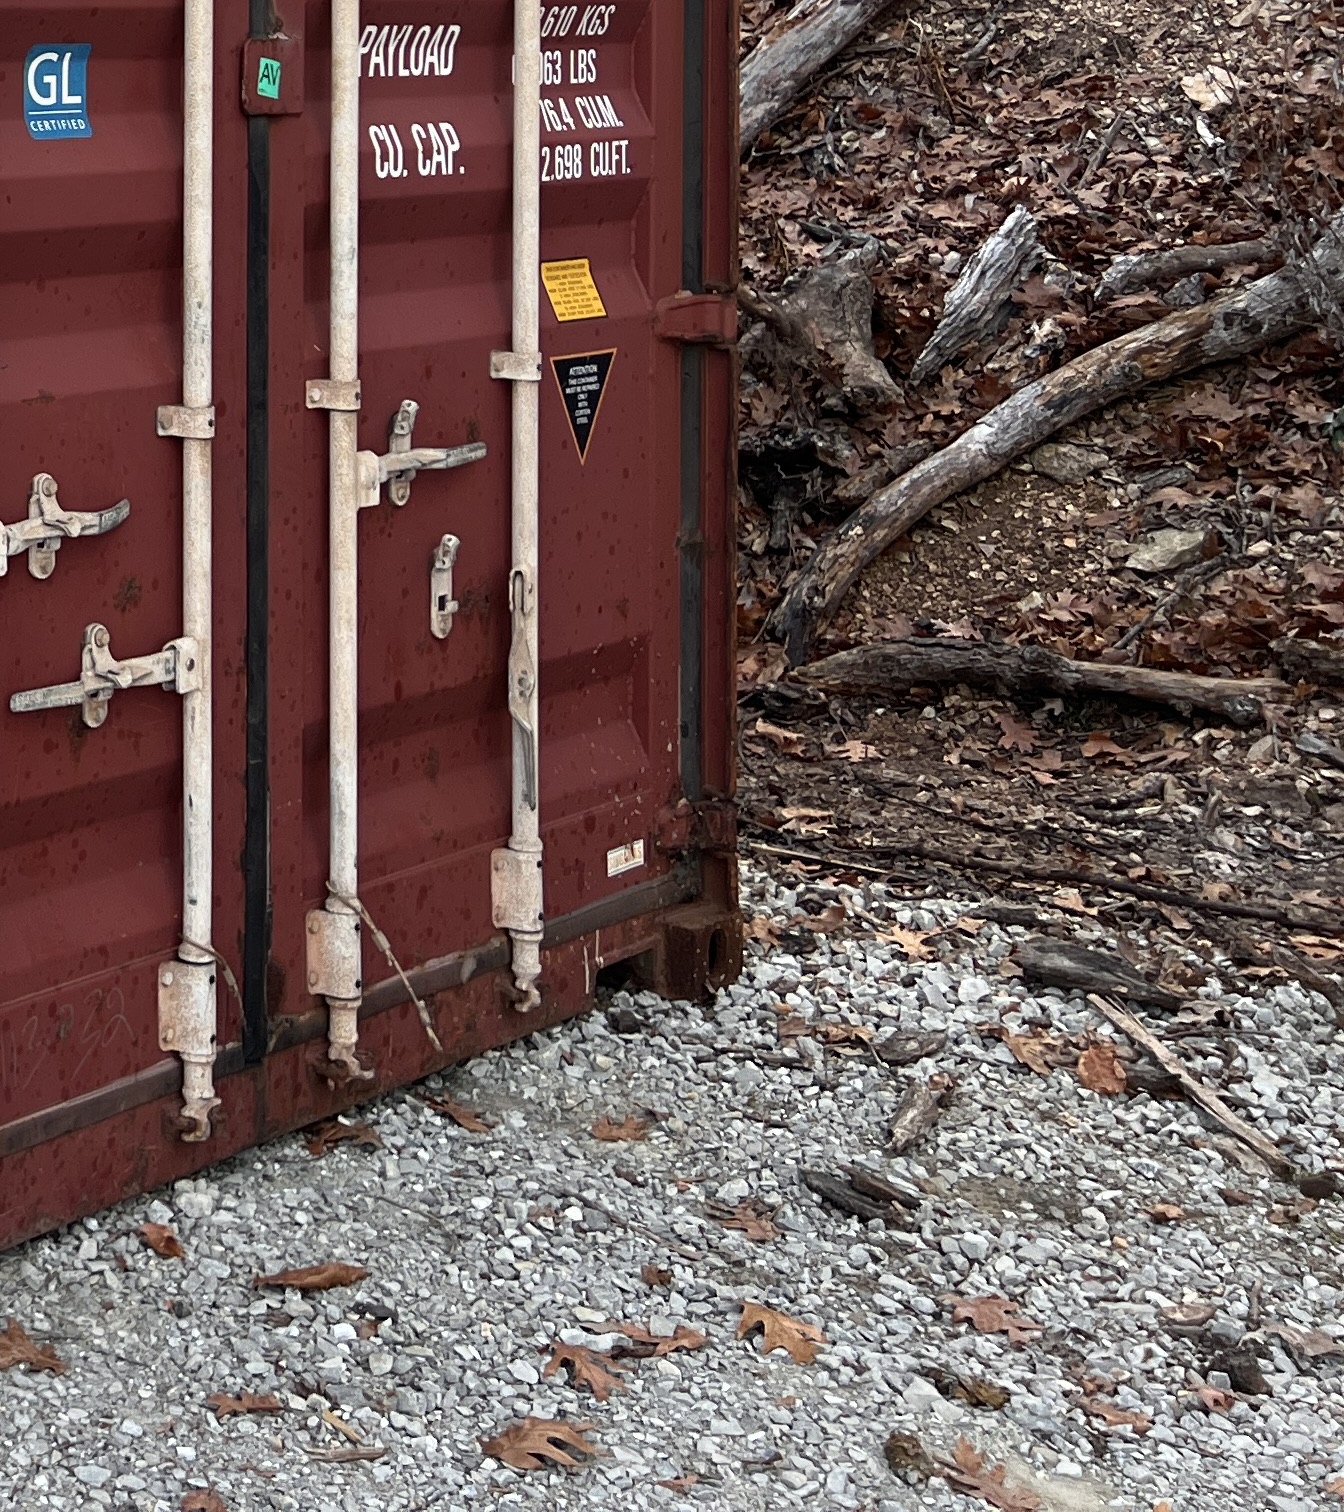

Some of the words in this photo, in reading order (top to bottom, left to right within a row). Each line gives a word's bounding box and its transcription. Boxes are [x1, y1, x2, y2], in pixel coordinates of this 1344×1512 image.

[358, 24, 462, 78] PAYLOAD
[575, 5, 616, 36] KGS
[570, 49, 597, 84] LBS
[27, 52, 82, 106] GL
[30, 118, 86, 132] CERTIFIED
[368, 124, 408, 179] CU.
[410, 122, 466, 177] CAP.
